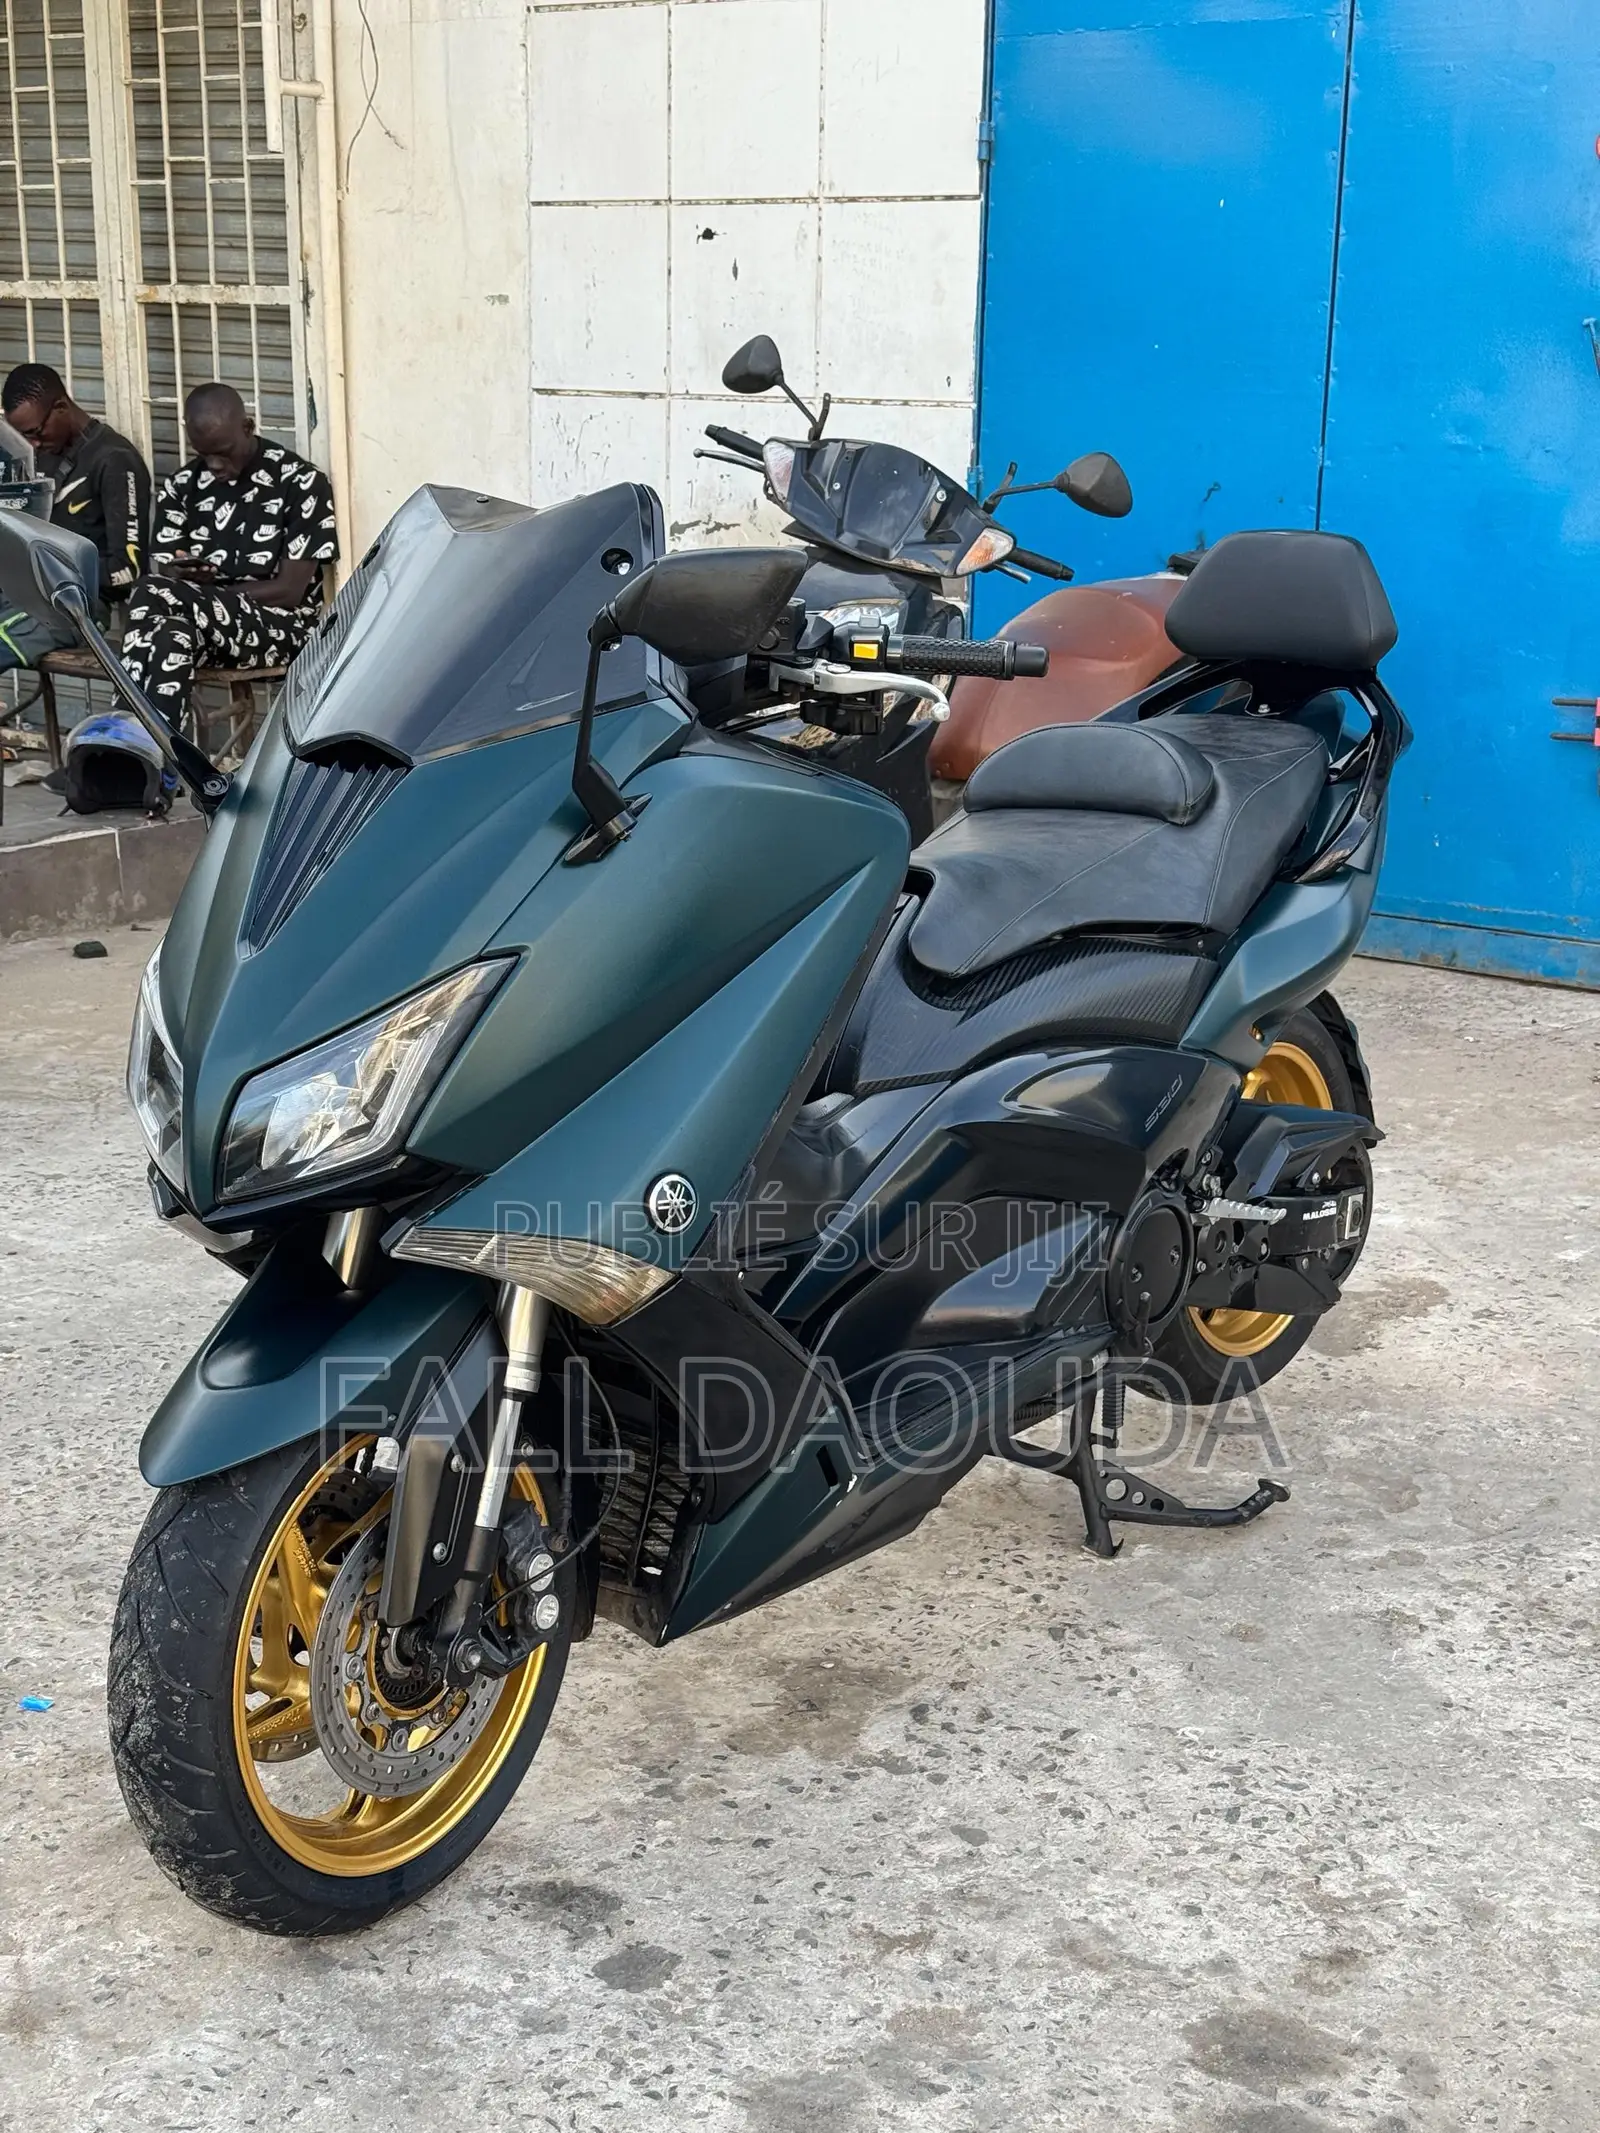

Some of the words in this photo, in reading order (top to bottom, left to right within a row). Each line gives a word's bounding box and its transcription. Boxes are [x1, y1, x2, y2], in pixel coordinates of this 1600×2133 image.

[214, 501, 232, 521] NIKE
[126, 518, 139, 542] TM
[259, 524, 277, 535] NIKE
[287, 533, 306, 554] NIKE
[110, 566, 134, 586] NIKE
[168, 652, 188, 664] NIKE
[1144, 1073, 1183, 1133] 530
[1302, 1206, 1337, 1221] MALOSSI
